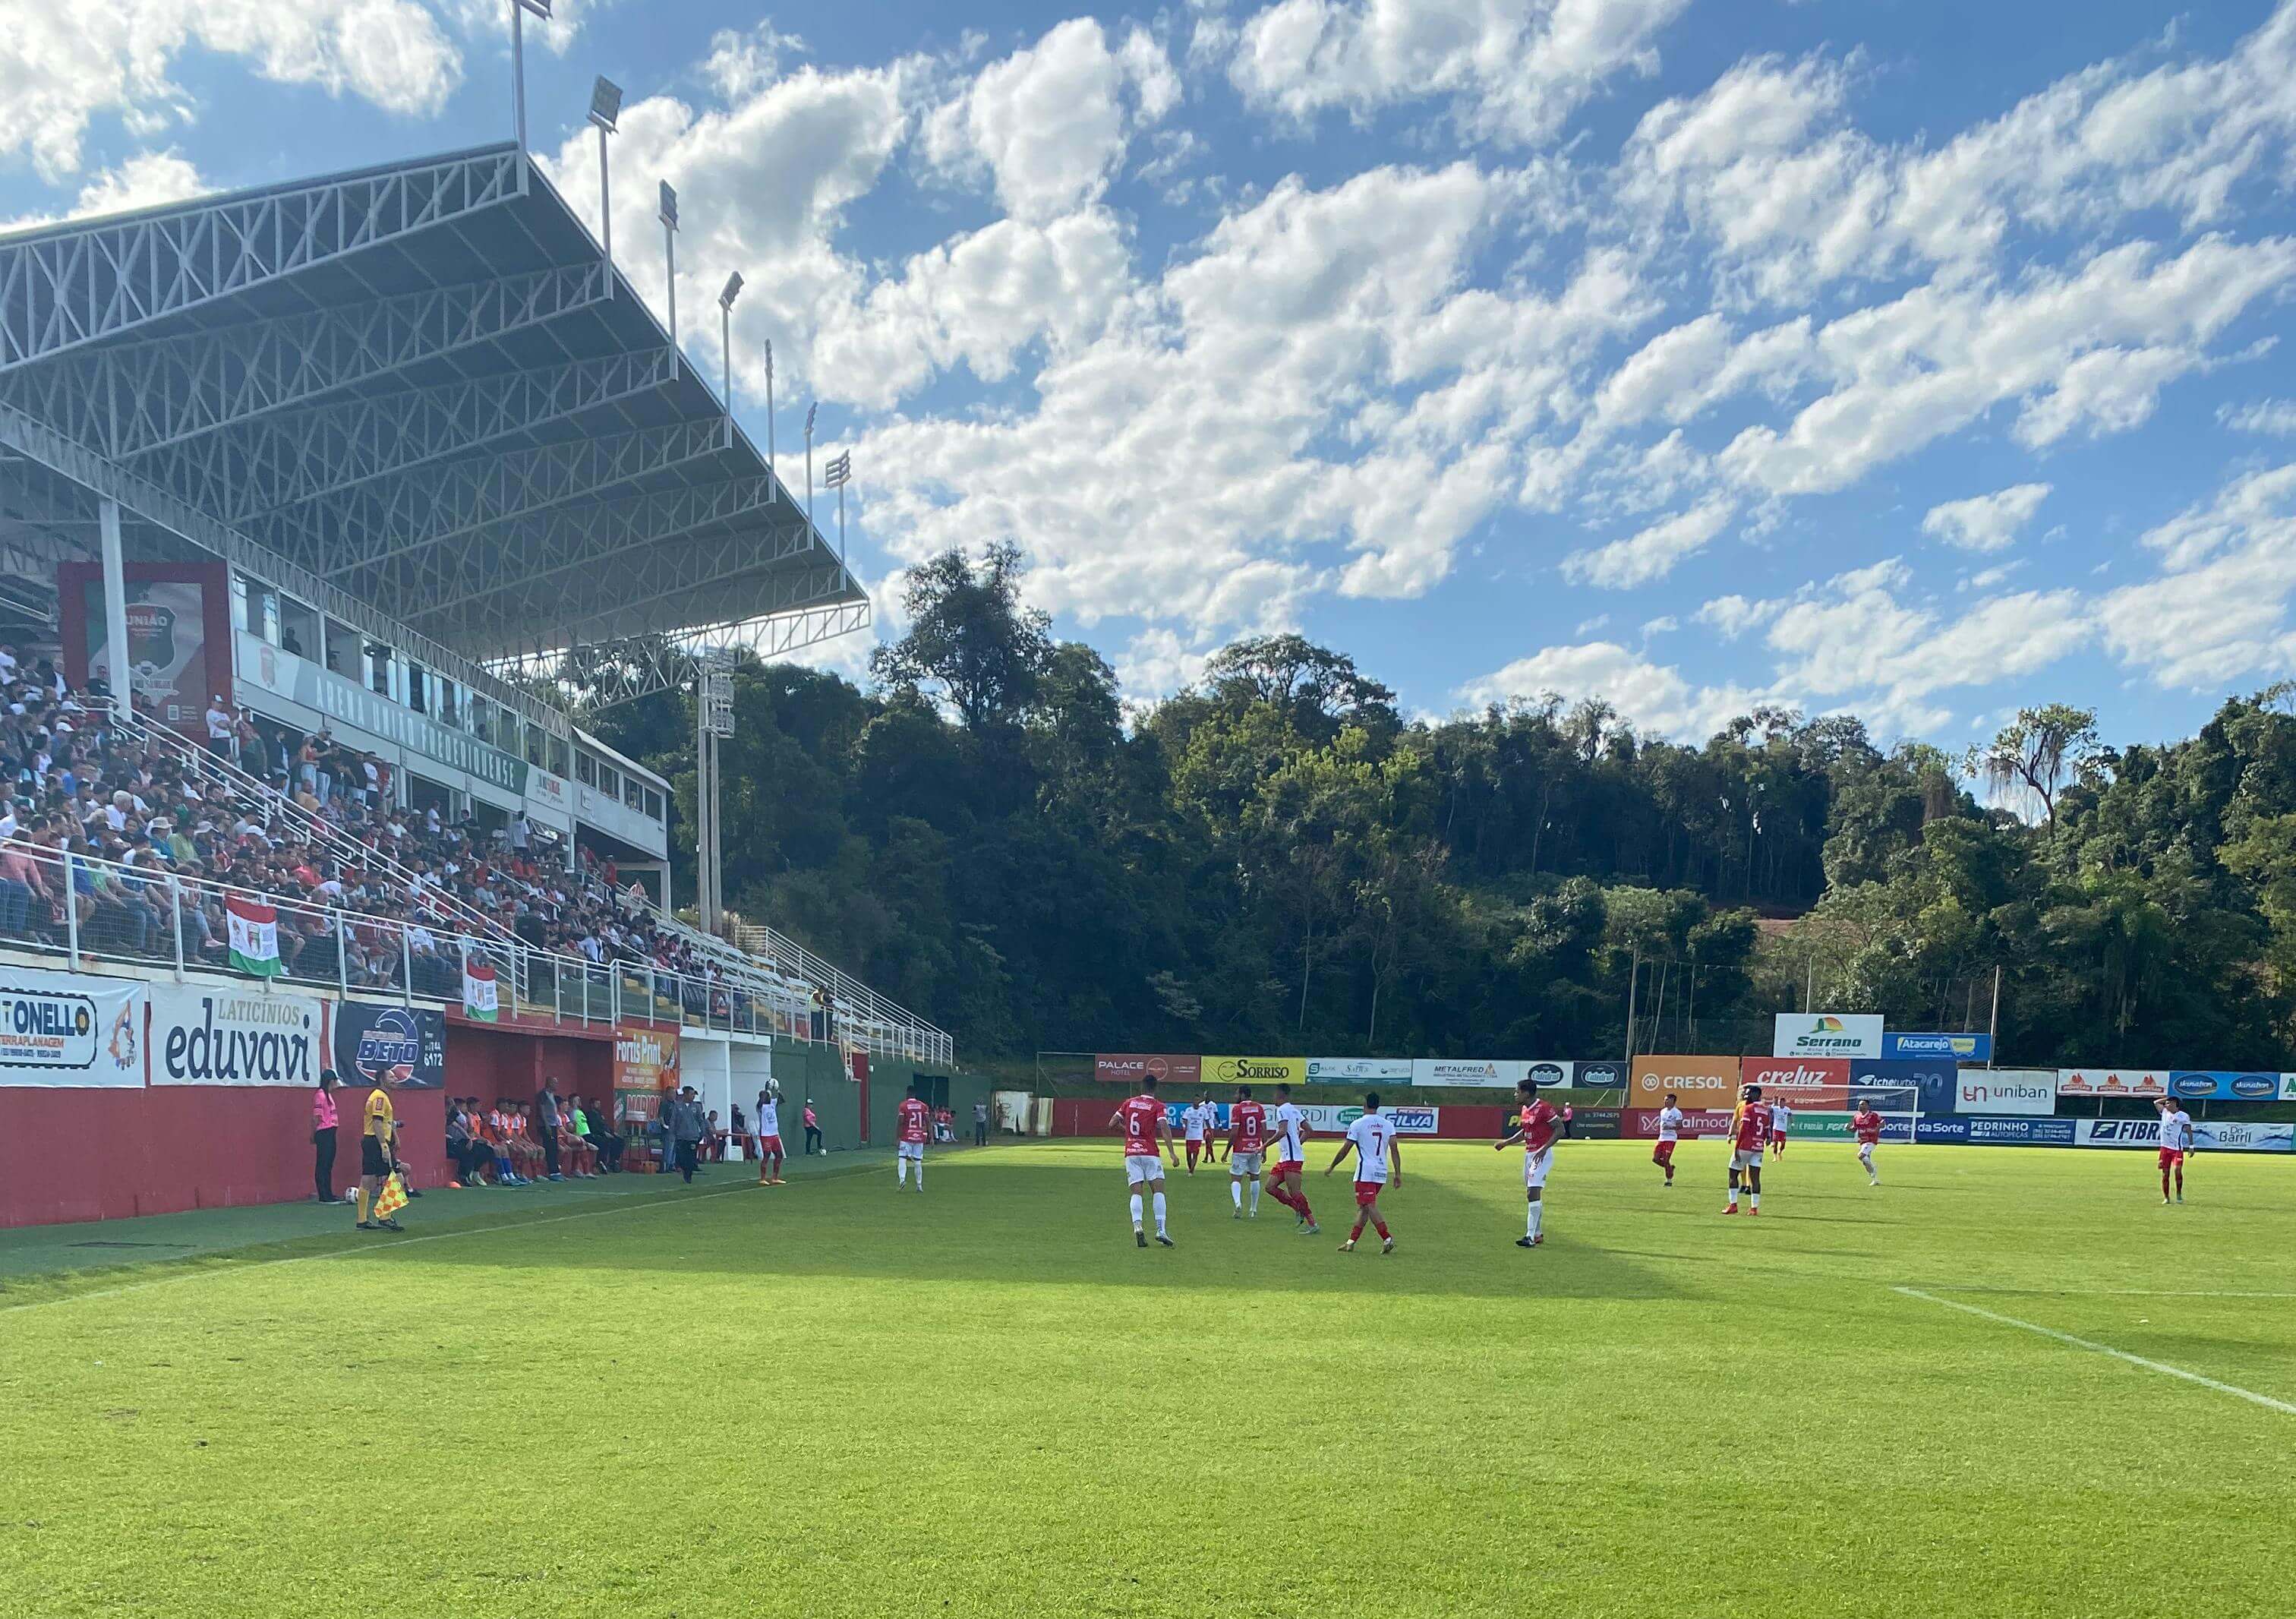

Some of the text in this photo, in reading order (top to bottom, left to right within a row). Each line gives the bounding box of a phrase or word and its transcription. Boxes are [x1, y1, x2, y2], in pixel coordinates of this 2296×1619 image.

[316, 674, 364, 726] ARENA
[373, 700, 415, 746] UNIÃO
[421, 722, 515, 788] FREDERIQUENSE
[166, 996, 310, 1082] eduvavi
[1796, 1036, 1862, 1048] Serrano
[1902, 1039, 1949, 1050] Atacarejo
[356, 1039, 419, 1063] BETO
[1098, 1061, 1144, 1070] PALACE
[1236, 1059, 1289, 1079] SORRISO
[1434, 1065, 1484, 1074] METALFRED
[1757, 1064, 1828, 1085] creluz
[1663, 1075, 1728, 1090] CRESOL
[1994, 1084, 2048, 1099] uniban
[909, 1111, 922, 1128] 21
[1130, 1112, 1140, 1136] 6
[1246, 1116, 1257, 1136] 8
[1386, 1114, 1433, 1128] SILVA
[1755, 1116, 1764, 1136] 5
[1918, 1120, 1932, 1132] da
[1933, 1122, 1964, 1134] Sorte
[1971, 1121, 2029, 1132] PEDRINHO
[1990, 1131, 2029, 1139] AUTOPEÇAS
[2118, 1122, 2161, 1140] FIBR
[2219, 1131, 2252, 1143] Barril
[2230, 1126, 2243, 1135] Do
[1372, 1131, 1382, 1156] 7
